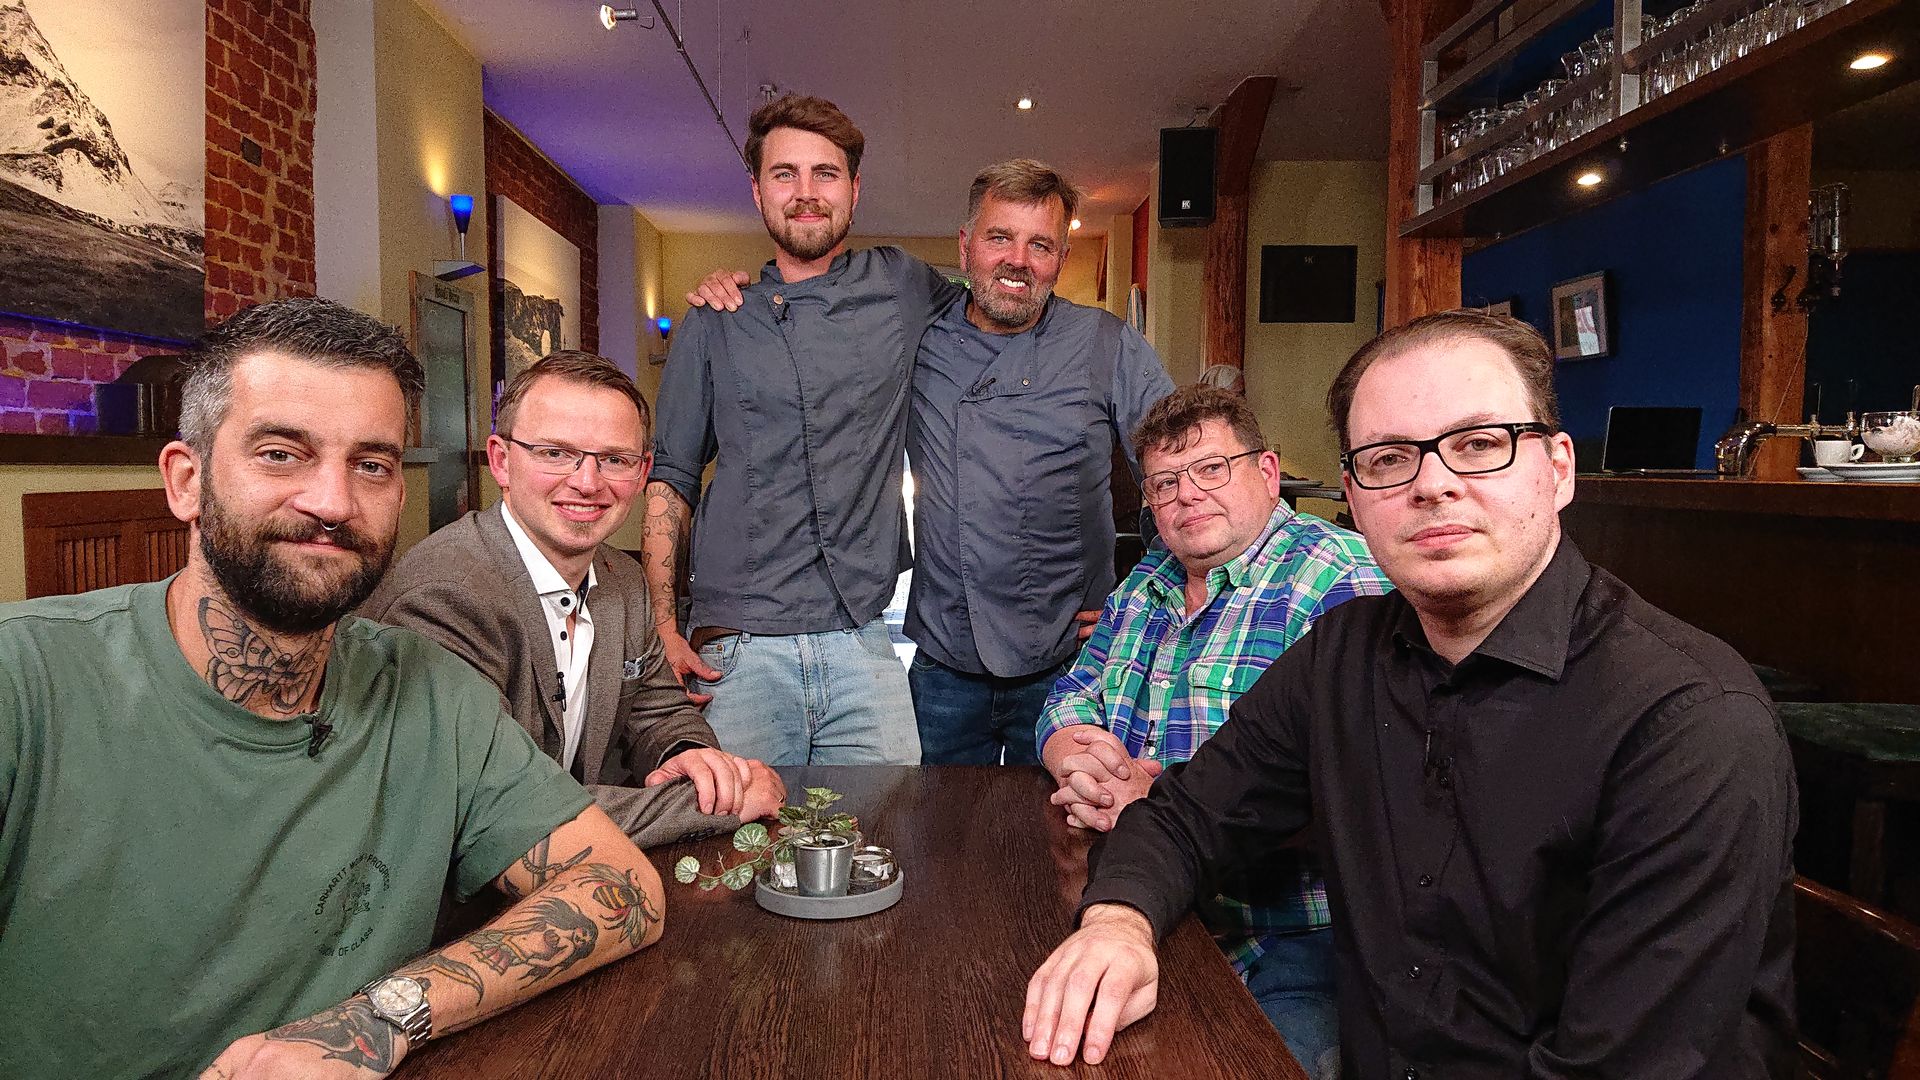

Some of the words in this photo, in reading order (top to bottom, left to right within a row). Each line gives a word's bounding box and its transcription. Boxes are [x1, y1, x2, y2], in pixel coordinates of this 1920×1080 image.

[315, 867, 347, 915] CARHARTT
[338, 946, 349, 956] OF
[351, 927, 373, 951] CLASS
